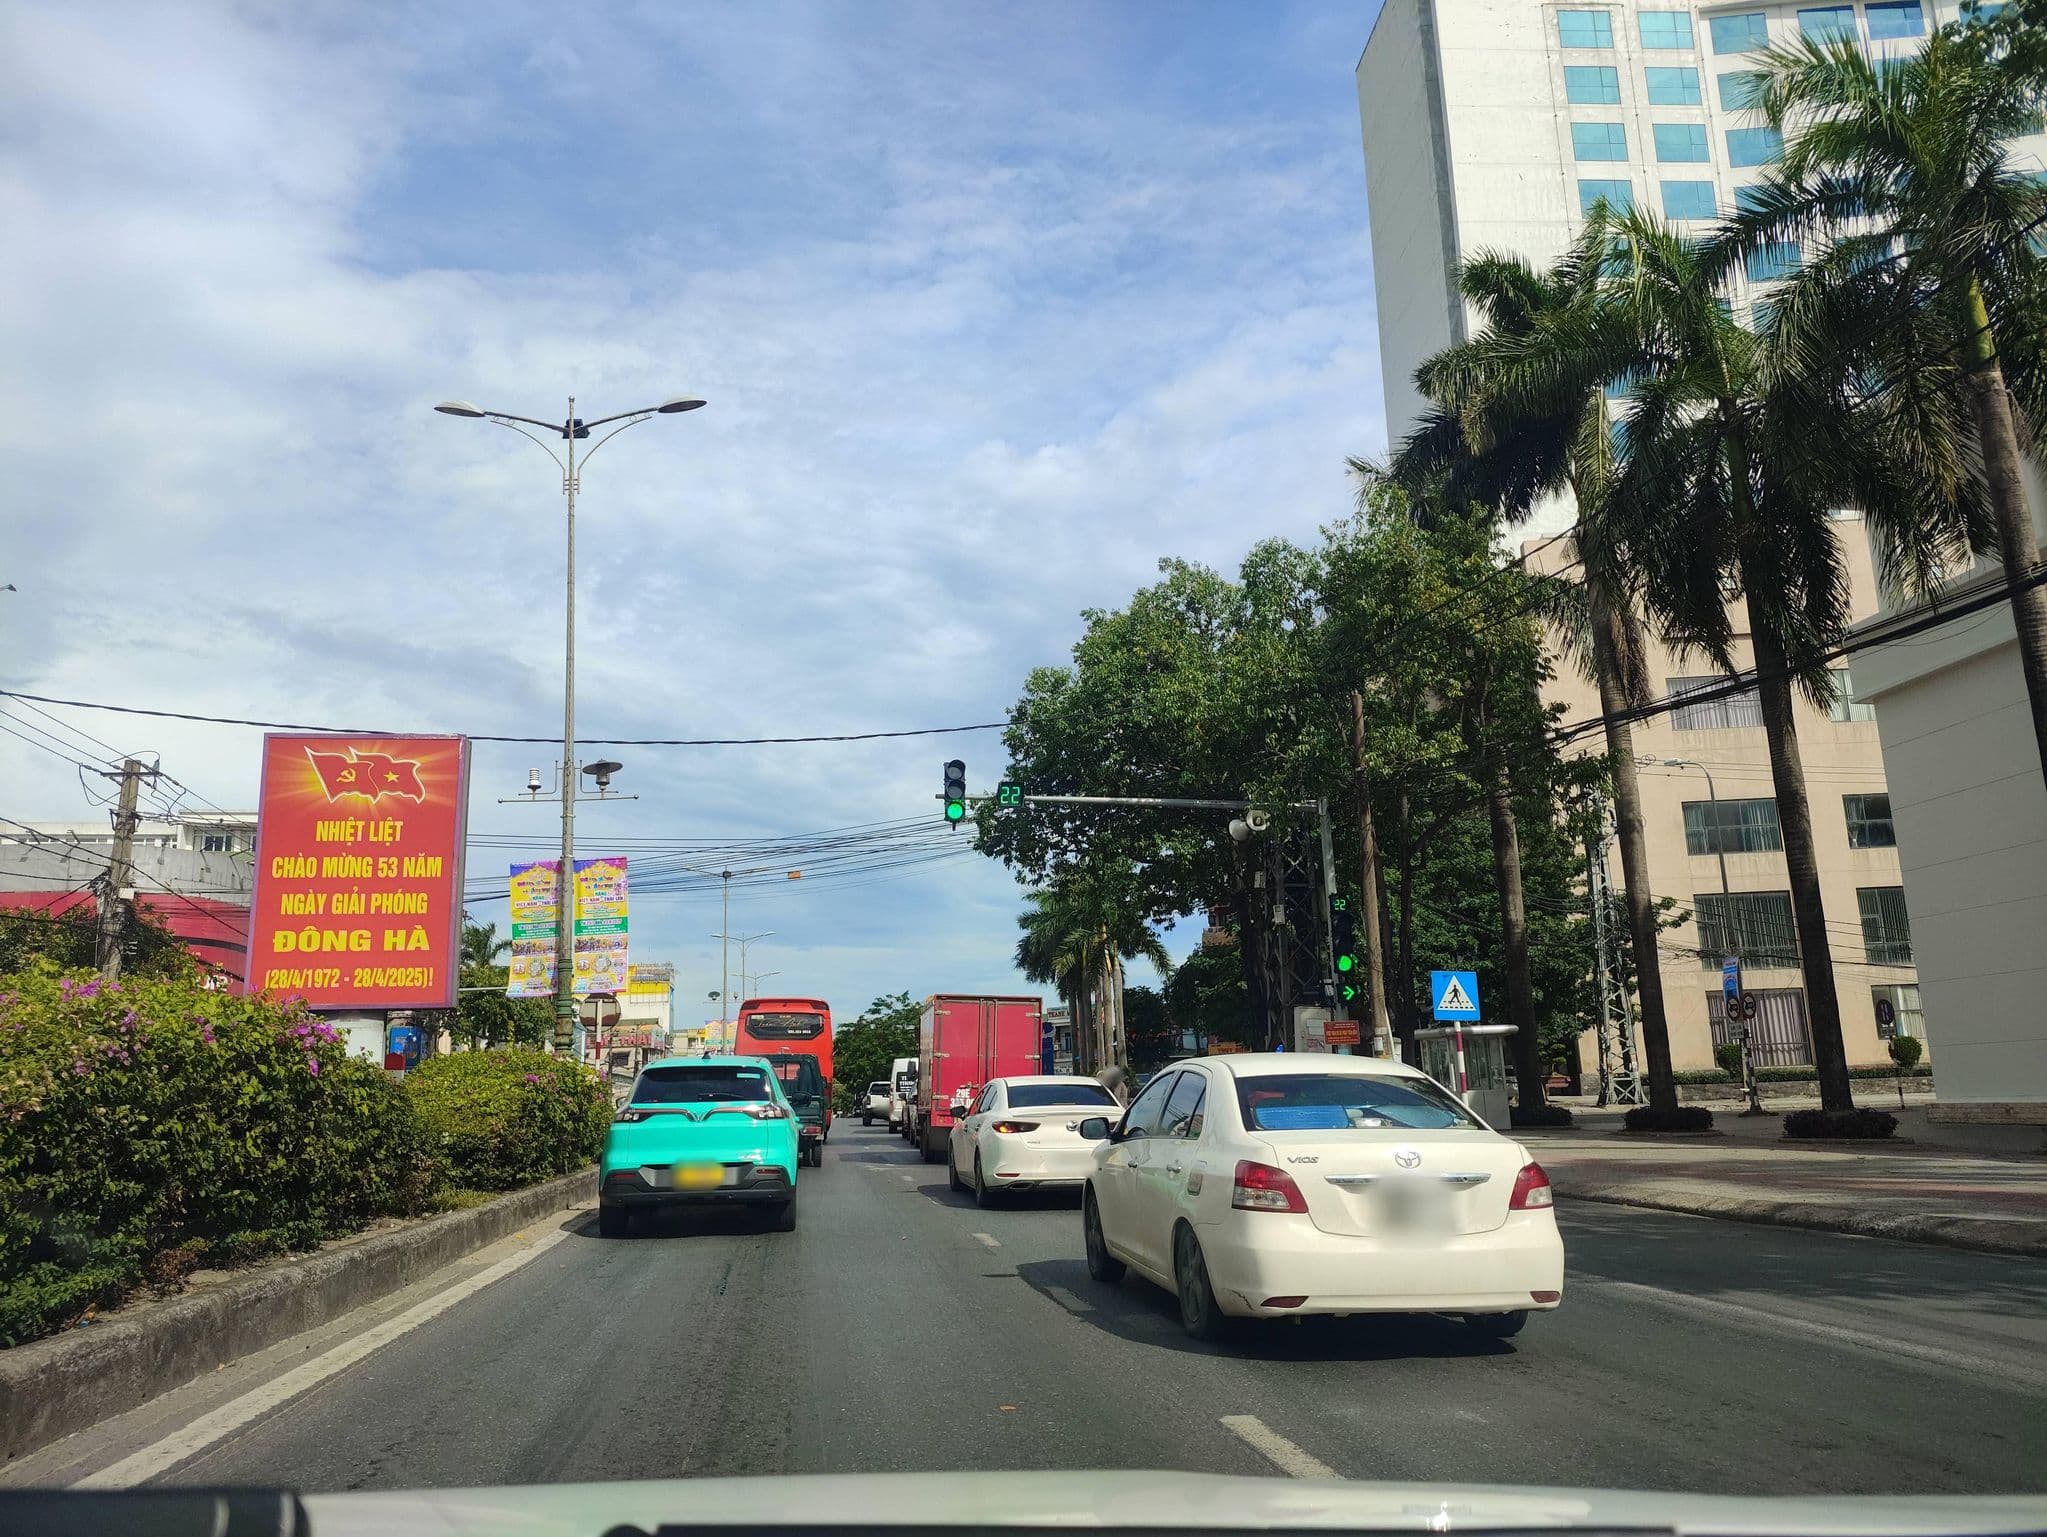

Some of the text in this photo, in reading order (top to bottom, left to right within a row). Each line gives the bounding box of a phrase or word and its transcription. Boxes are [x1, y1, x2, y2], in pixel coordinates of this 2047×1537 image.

[1000, 786, 1020, 804] 22
[315, 817, 403, 846] NHIỆT LIỆT
[272, 852, 443, 878] CHÀO MỪNG 53 NĂM
[280, 886, 428, 915] NGÀY GIẢI PHÓNG
[1334, 899, 1346, 910] 22
[273, 924, 430, 952] ĐÔNG HÀ
[265, 968, 340, 989] (28/4/1972
[353, 967, 434, 988] 28/4/2025)!
[1286, 1156, 1319, 1164] VIOS
